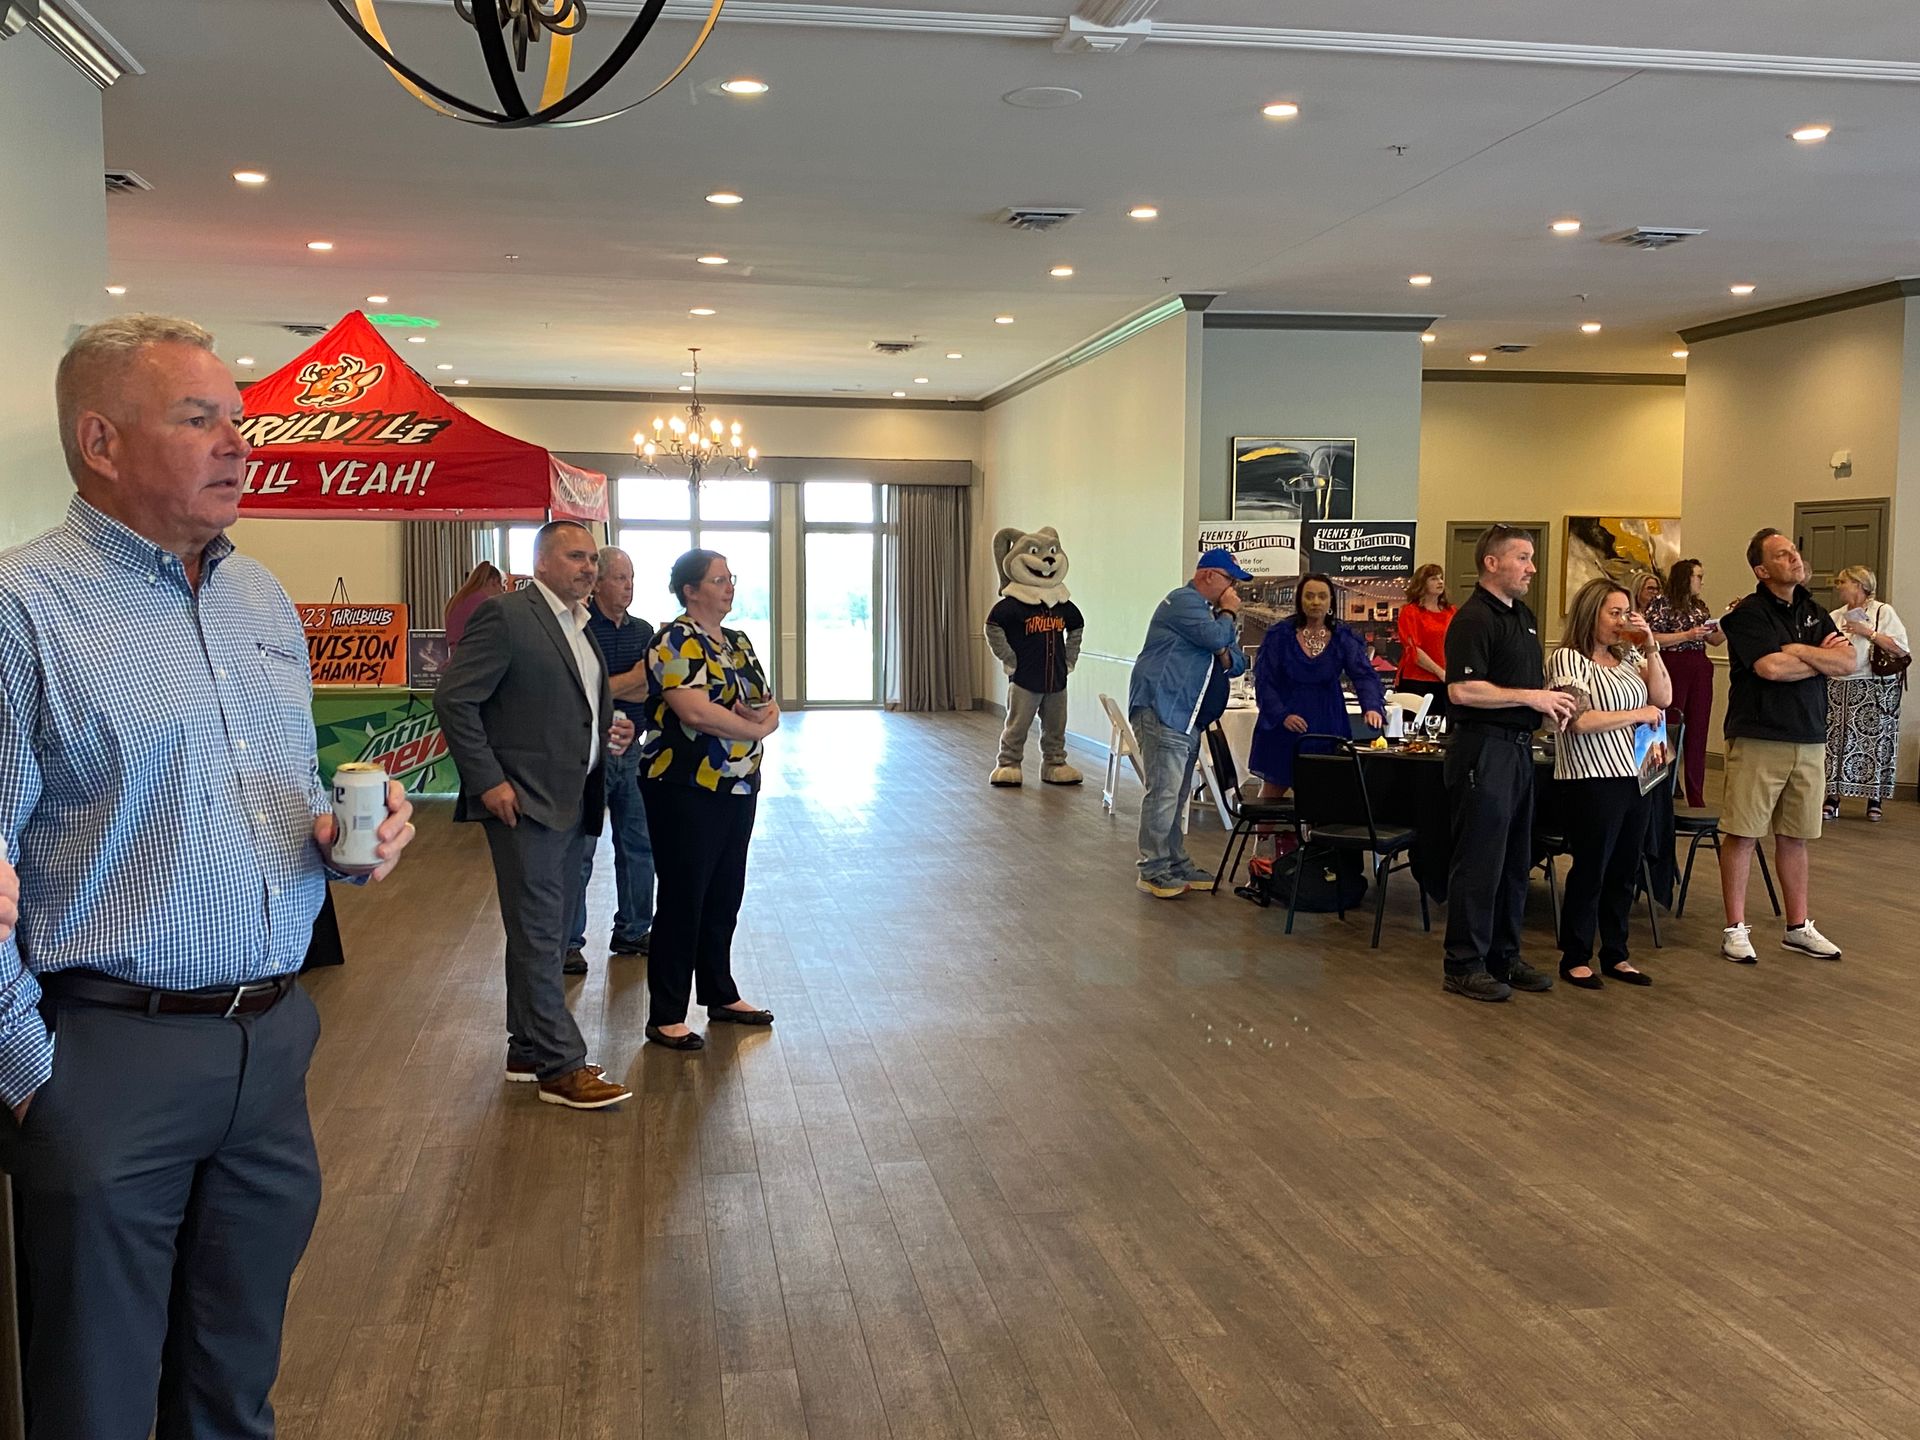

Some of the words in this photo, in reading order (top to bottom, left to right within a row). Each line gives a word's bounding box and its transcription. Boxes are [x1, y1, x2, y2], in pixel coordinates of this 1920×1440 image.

[238, 411, 440, 447] RILLVILLE
[242, 460, 298, 494] ILL
[318, 460, 436, 496] YEAH!
[1200, 531, 1234, 541] EVENTS
[1235, 530, 1248, 540] BY
[1316, 528, 1350, 539] EVENTS
[1350, 528, 1364, 538] BY
[1341, 564, 1355, 572] your
[1357, 564, 1380, 572] special
[1353, 555, 1377, 563] perfect
[302, 608, 326, 627] '23
[307, 634, 399, 660] IVISION
[311, 661, 387, 683] CHAMPS!
